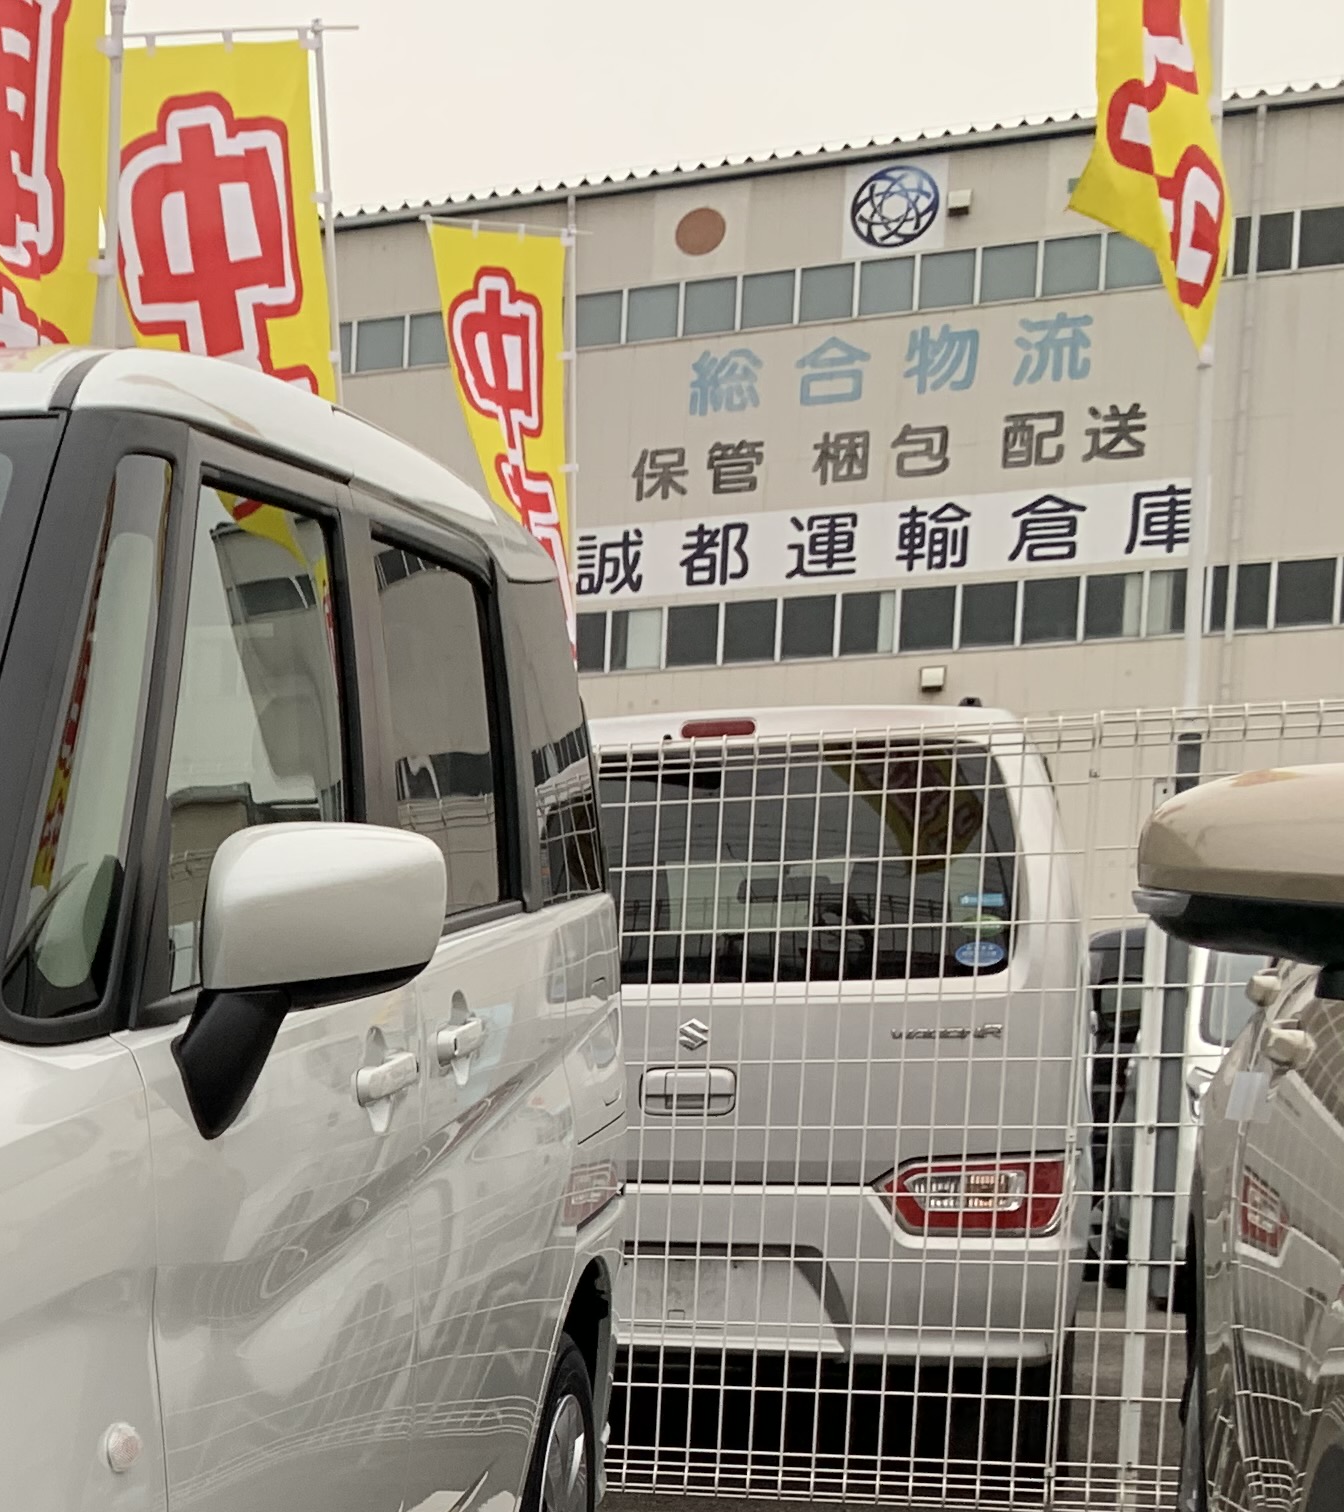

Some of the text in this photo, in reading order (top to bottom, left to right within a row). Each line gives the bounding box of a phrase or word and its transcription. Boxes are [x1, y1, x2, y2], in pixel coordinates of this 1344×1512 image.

[688, 312, 1094, 417] 総合物流
[632, 402, 1147, 502] 保管 梱包 配送
[574, 484, 1193, 597] 誠都運輸倉庫
